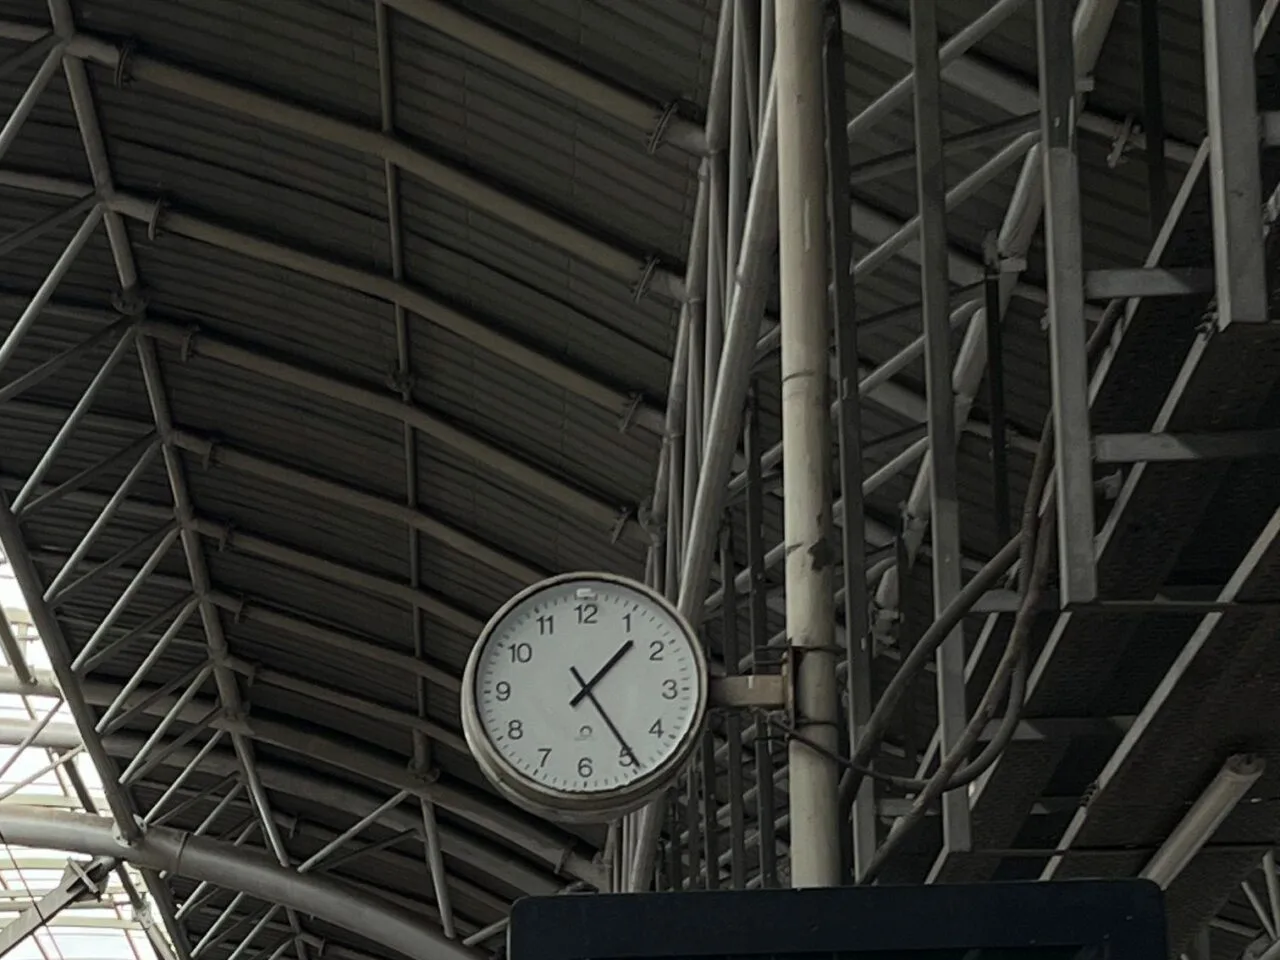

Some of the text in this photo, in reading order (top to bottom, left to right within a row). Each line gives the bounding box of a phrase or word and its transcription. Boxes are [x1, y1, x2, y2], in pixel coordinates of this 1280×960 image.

[536, 615, 554, 635] 11
[575, 604, 598, 625] 12
[622, 613, 632, 633] 1
[508, 642, 532, 664] 10
[649, 641, 664, 662] 2
[496, 681, 511, 702] 9
[662, 679, 678, 700] 3
[508, 719, 523, 740] 8
[648, 719, 664, 739] 4
[537, 748, 552, 768] 7
[577, 757, 593, 778] 6
[618, 747, 635, 767] 5
